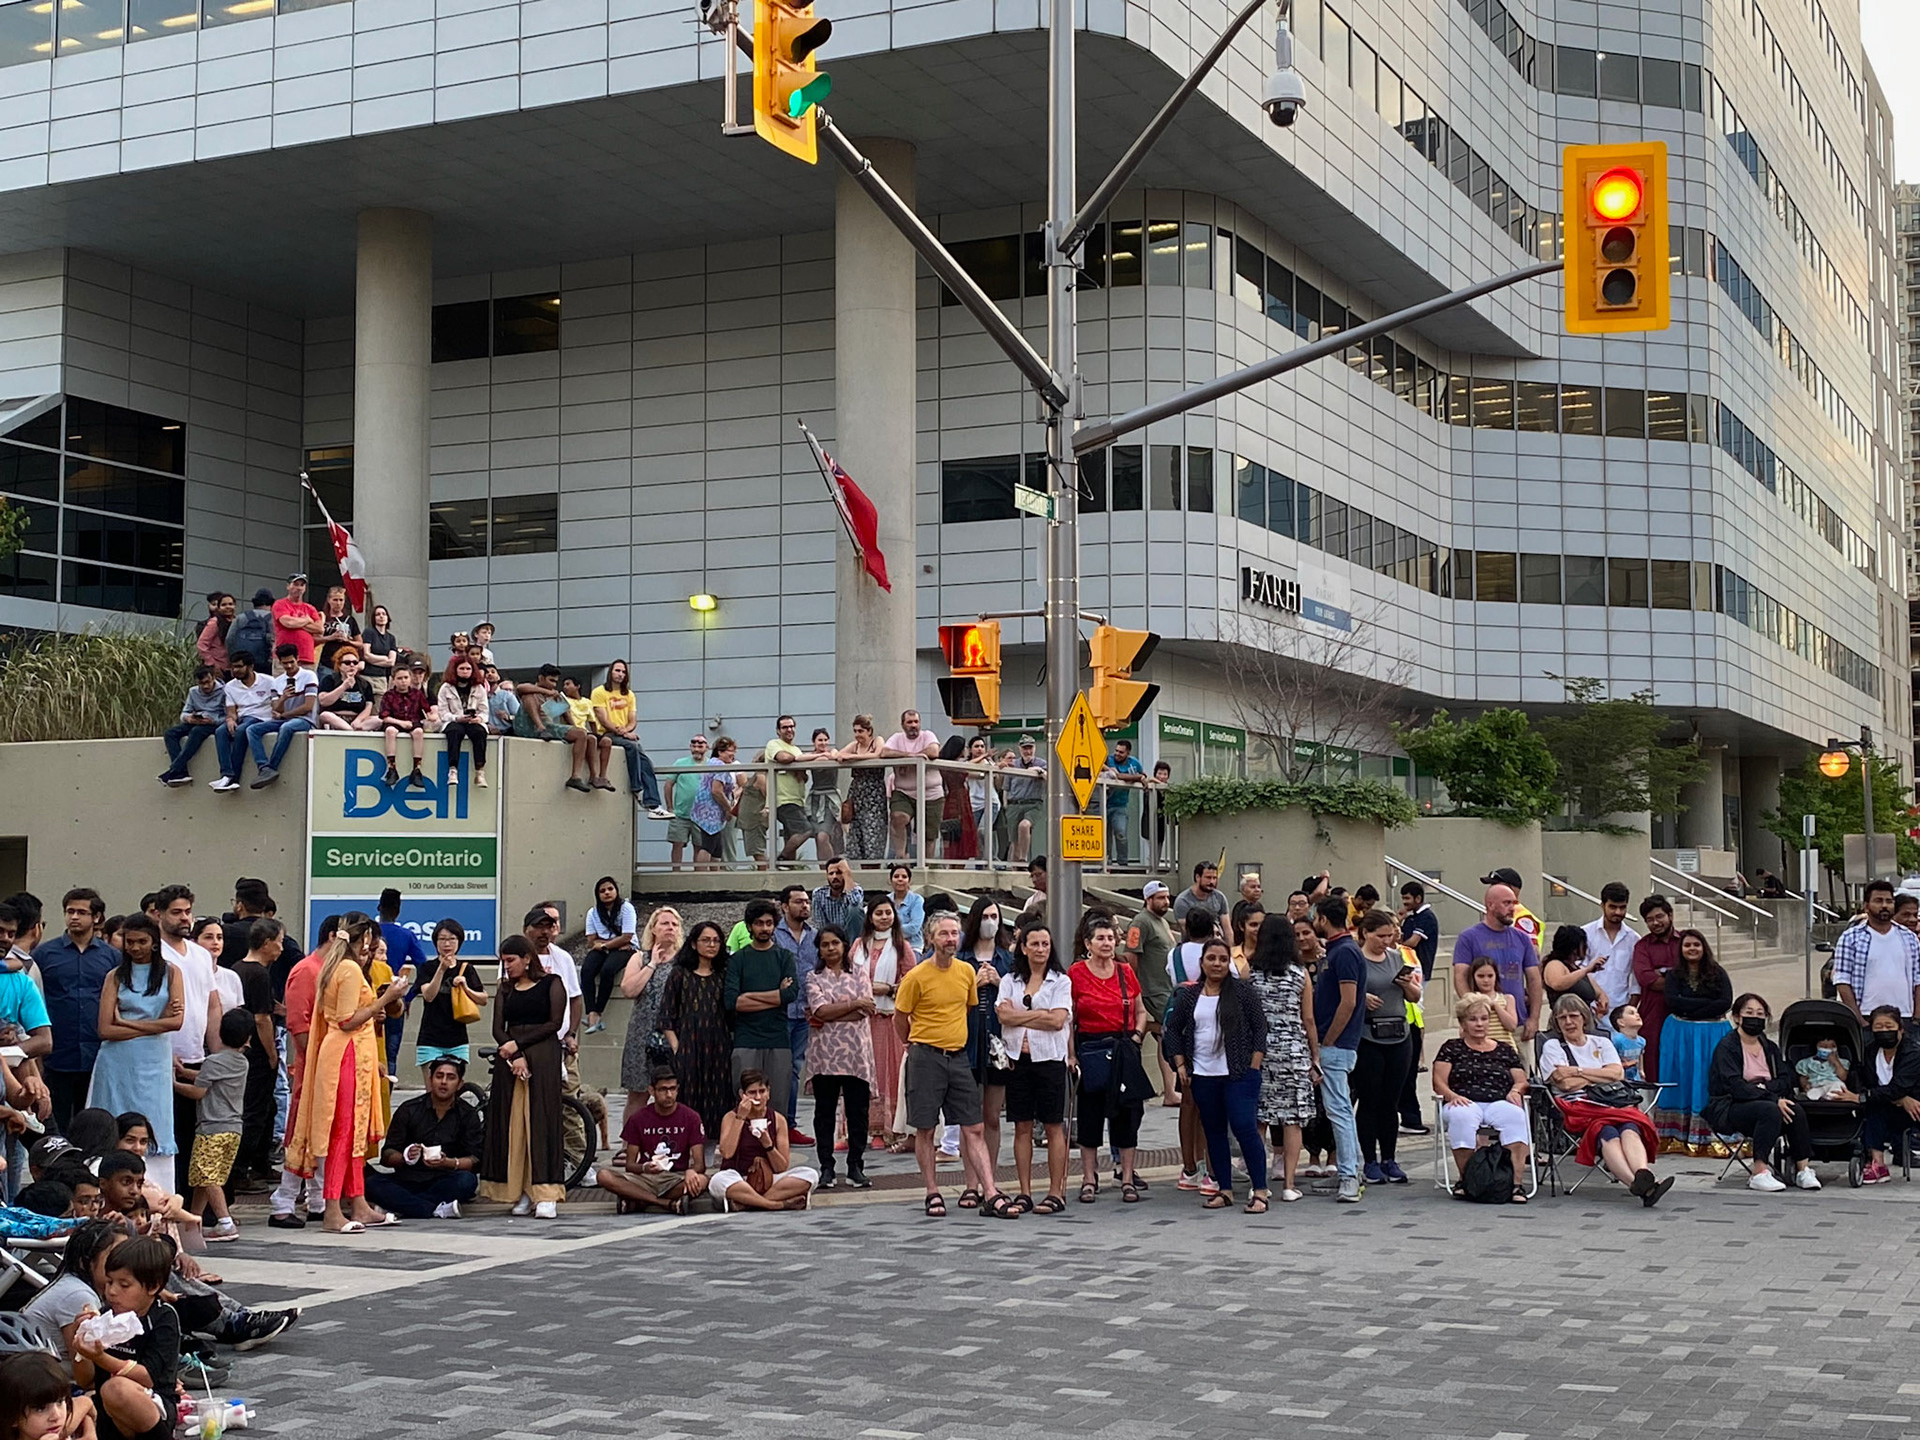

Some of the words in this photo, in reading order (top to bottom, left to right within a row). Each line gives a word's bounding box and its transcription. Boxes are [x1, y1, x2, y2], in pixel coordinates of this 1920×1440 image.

[1249, 566, 1304, 614] FARHI
[343, 748, 470, 820] Bell
[1071, 825, 1095, 836] SHARE
[1065, 839, 1079, 851] THE
[1080, 839, 1101, 851] ROAD
[326, 848, 483, 868] ServiceOntario
[408, 882, 422, 890] 100
[436, 882, 465, 890] Dundas
[466, 882, 488, 890] Street
